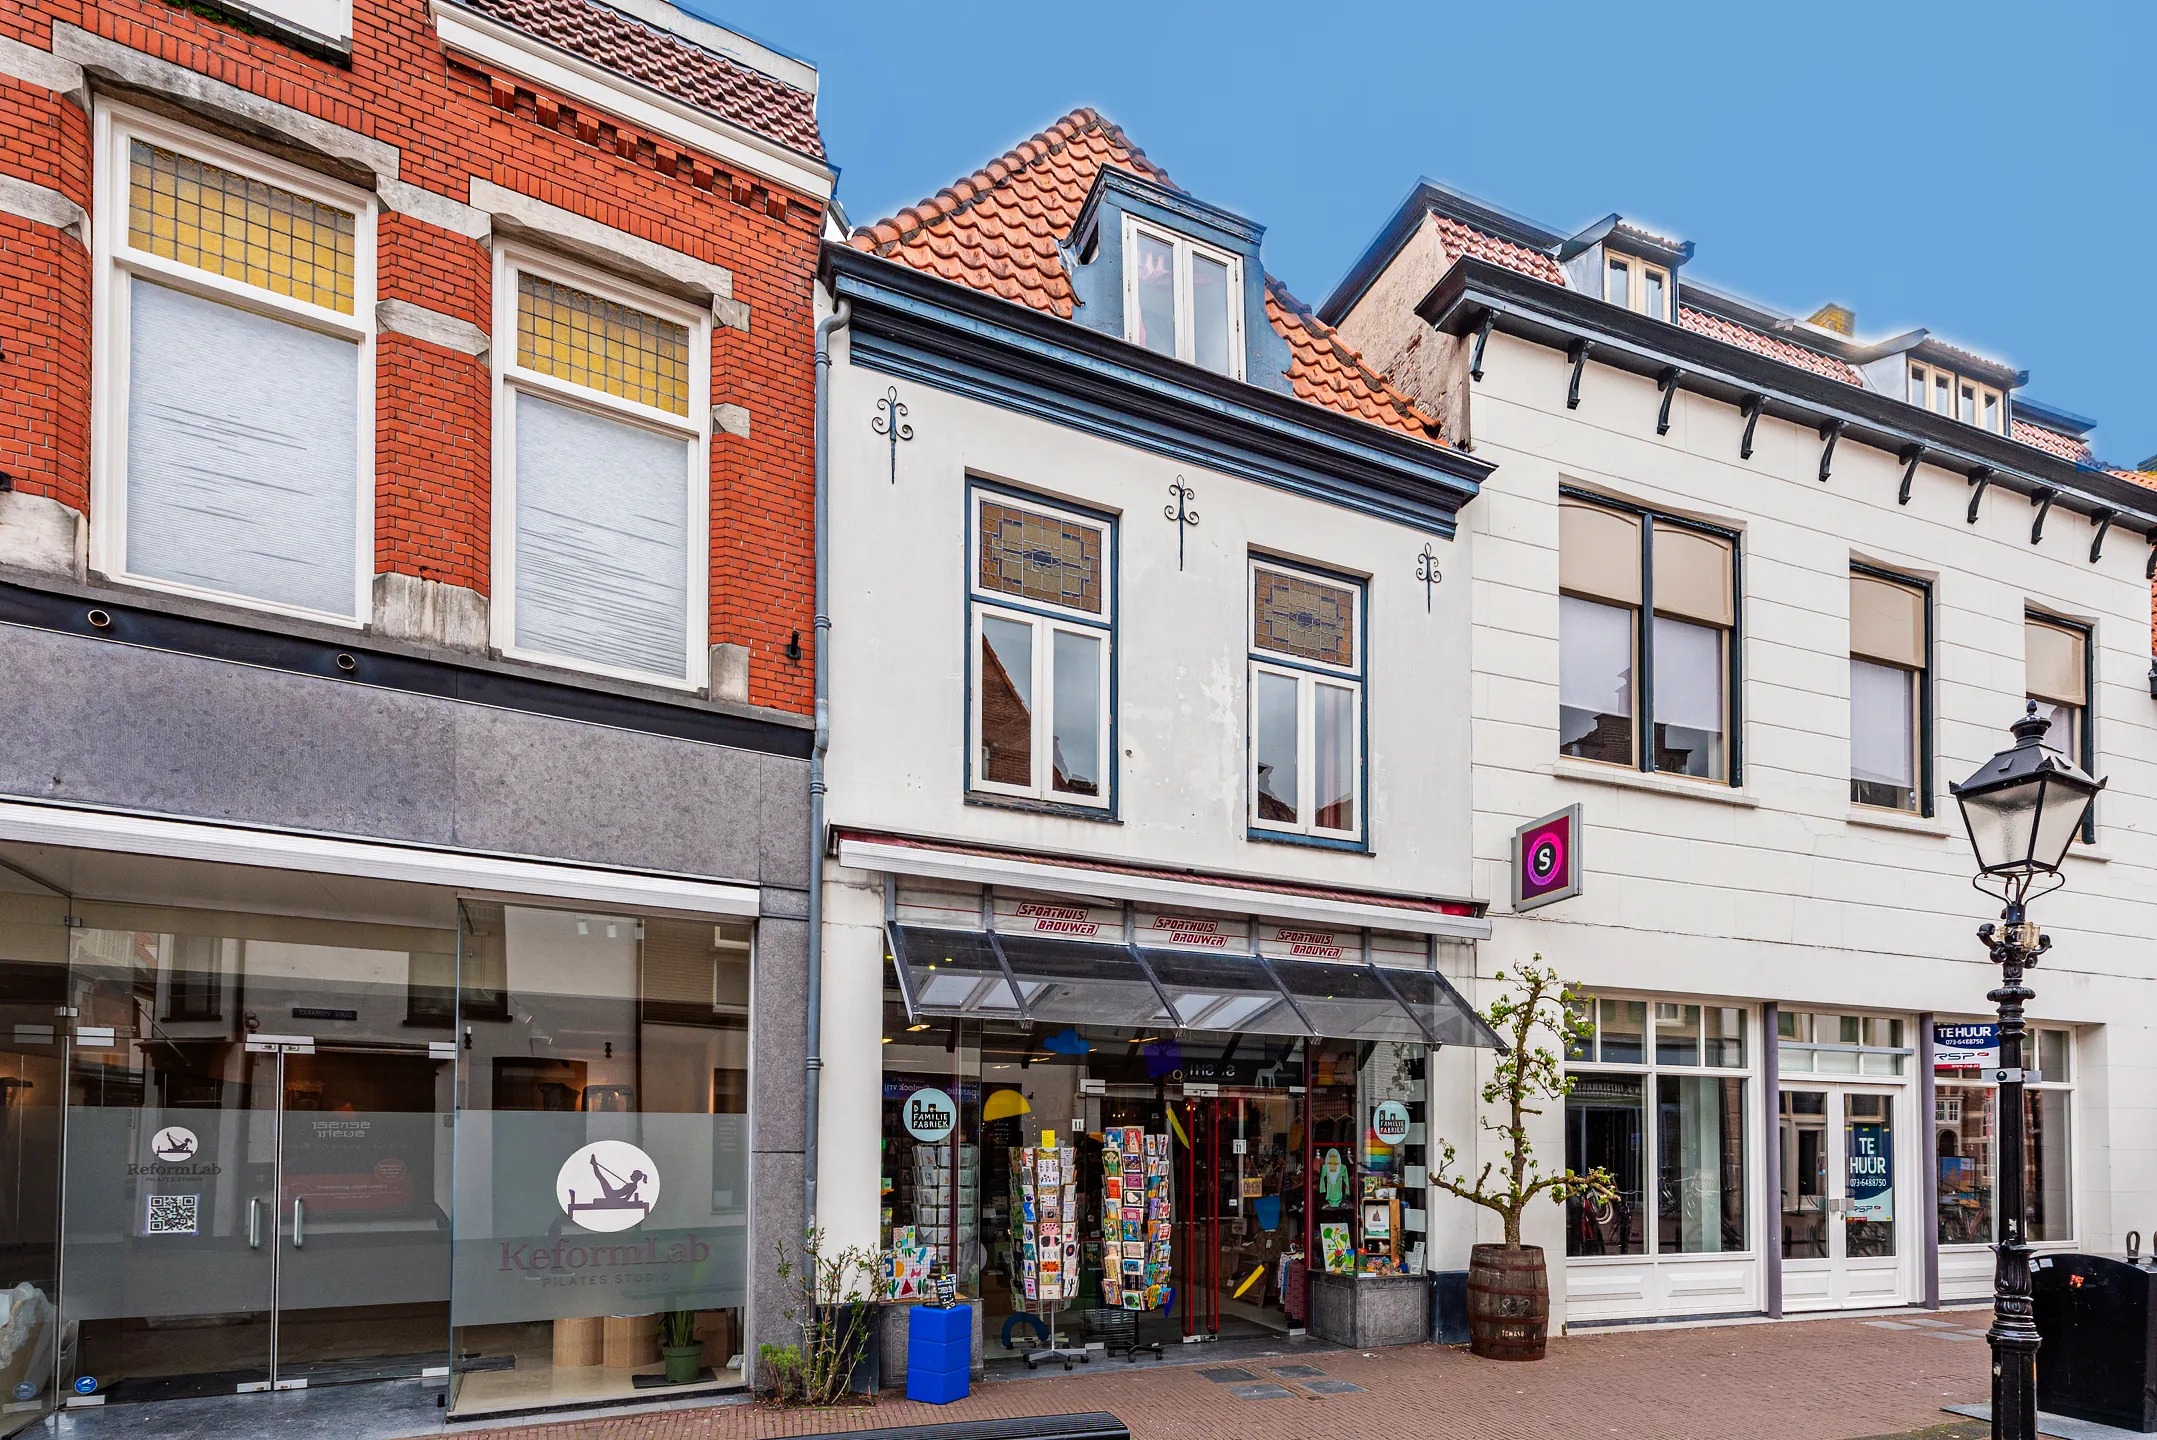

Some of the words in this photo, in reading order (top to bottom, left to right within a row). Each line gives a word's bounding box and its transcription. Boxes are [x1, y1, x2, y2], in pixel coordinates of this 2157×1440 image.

[1539, 848, 1551, 870] S
[1019, 903, 1086, 921] SPORTHUIS
[1037, 919, 1096, 935] BROUWER
[1155, 917, 1217, 933] SPORTHUIS
[1171, 931, 1226, 947] BROUWER
[1278, 929, 1332, 945] SPORTHUIS
[1293, 943, 1341, 958] BROUWER
[1938, 1027, 1954, 1038] TE
[1955, 1026, 1992, 1037] HUUR
[1935, 1052, 1975, 1060] RSP
[913, 1113, 948, 1121] FAMILIE
[913, 1121, 949, 1129] FABRIEK
[1858, 1138, 1875, 1154] TE
[127, 1163, 222, 1176] ReformLab
[1849, 1156, 1886, 1174] HUUR
[541, 1274, 609, 1288] PILATES
